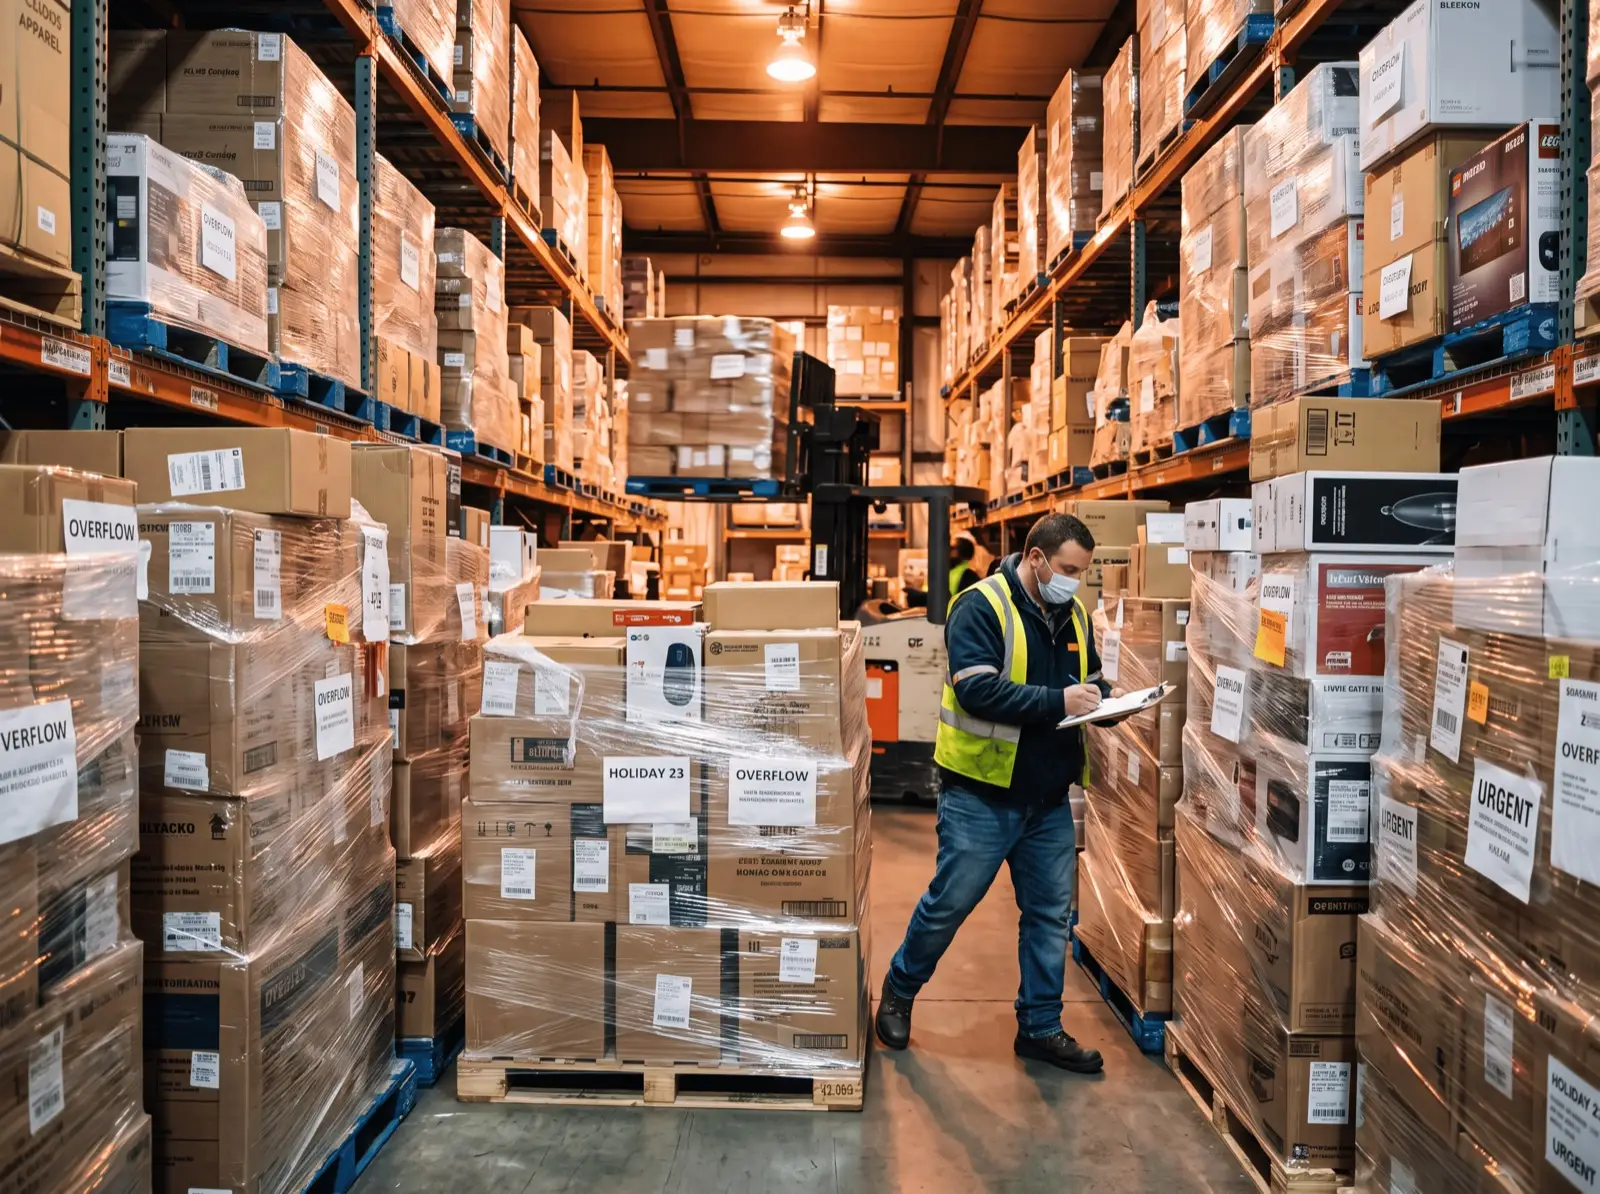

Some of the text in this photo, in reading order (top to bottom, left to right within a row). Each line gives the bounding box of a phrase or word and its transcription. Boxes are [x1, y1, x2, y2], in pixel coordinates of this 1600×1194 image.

[1440, 1, 1480, 9] BLEEKON
[19, 12, 62, 54] APPAREL
[1541, 135, 1560, 147] LEG
[69, 519, 135, 541] OVERFLOW
[1217, 676, 1242, 693] OVERFLOW
[318, 686, 350, 706] OVERFLOW
[609, 768, 684, 780] HOLIDAY 23
[736, 769, 809, 782] OVERFLOW
[1477, 778, 1533, 828] URGENT
[1381, 808, 1414, 841] URGENT
[1552, 1072, 1600, 1121] HOLIDAY 2
[1552, 1137, 1597, 1187] URGENT
